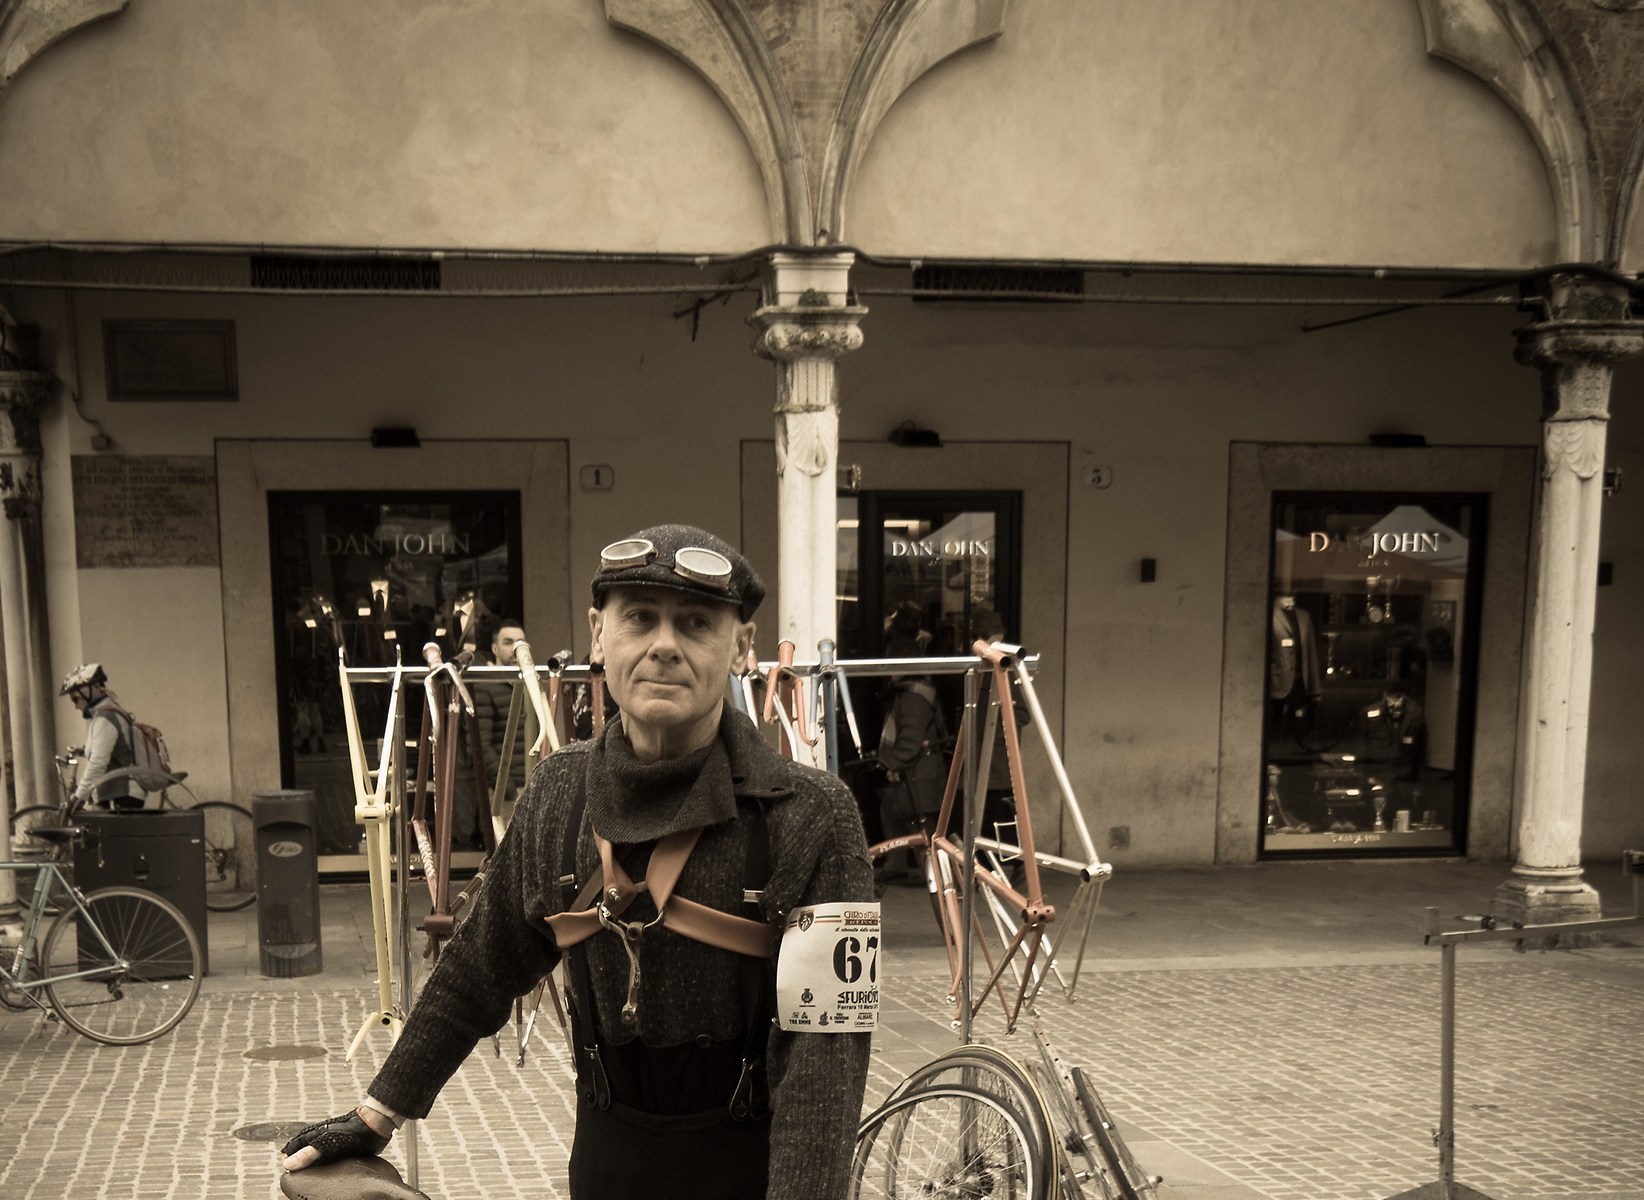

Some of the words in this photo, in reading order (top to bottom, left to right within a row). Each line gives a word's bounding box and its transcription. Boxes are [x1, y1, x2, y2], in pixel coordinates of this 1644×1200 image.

[320, 532, 384, 556] DAN
[390, 532, 470, 561] JOHN
[891, 539, 934, 557] DAN
[1367, 531, 1441, 560] JOHN
[833, 936, 879, 984] 67
